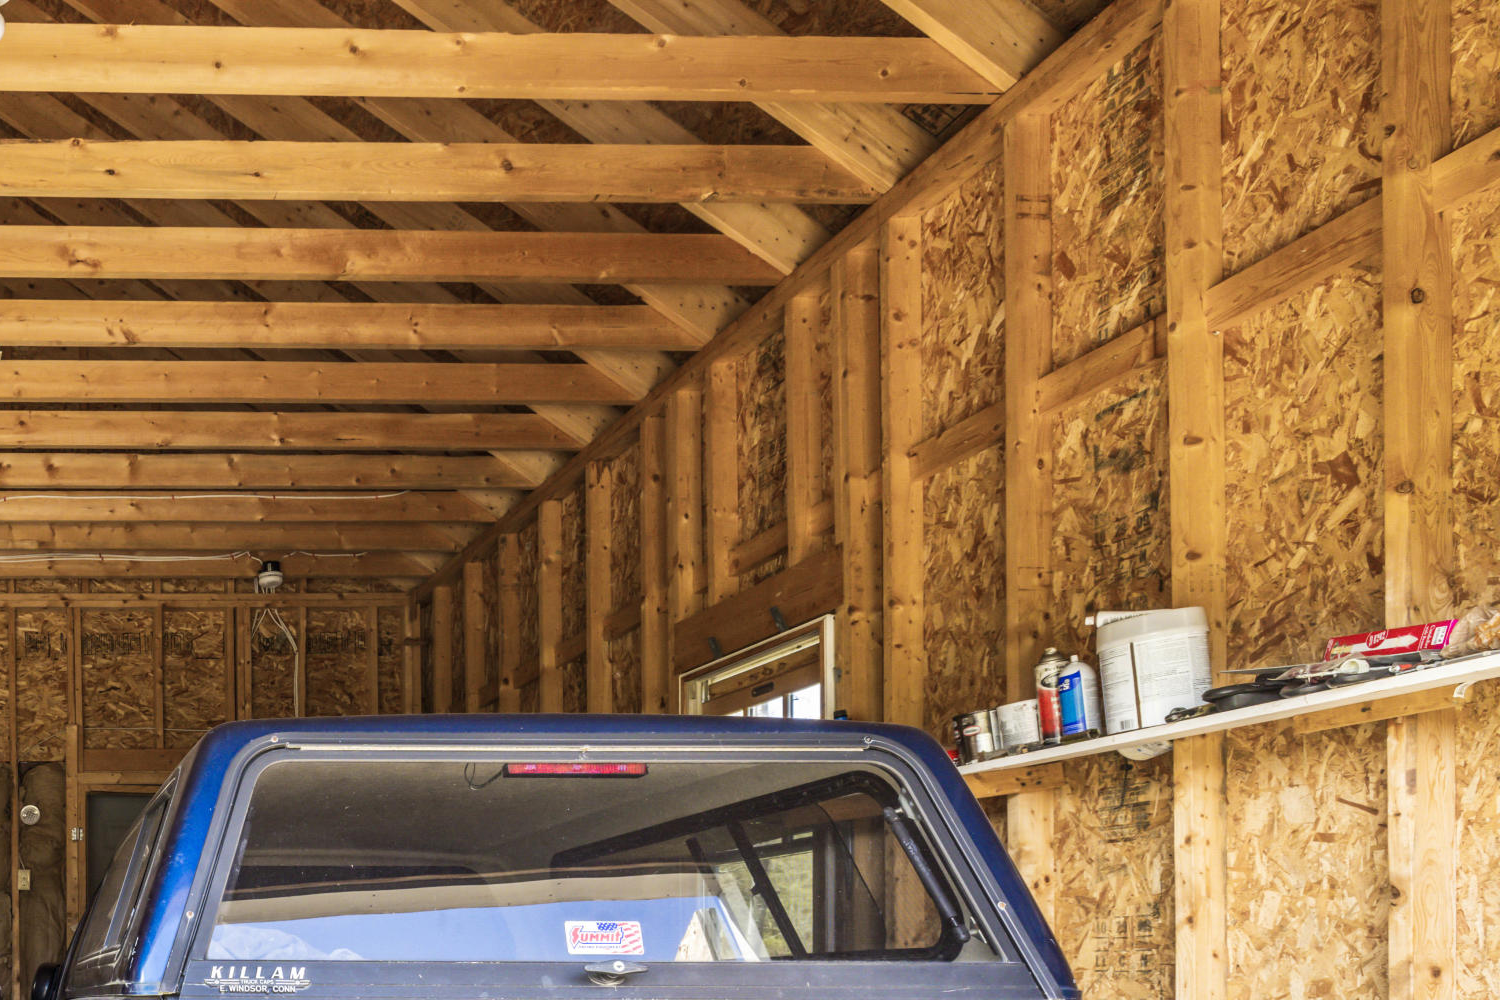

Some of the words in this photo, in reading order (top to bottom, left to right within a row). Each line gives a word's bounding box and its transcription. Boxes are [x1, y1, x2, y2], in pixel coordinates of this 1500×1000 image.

[210, 965, 306, 979] KILLAM
[219, 984, 228, 993] E.
[229, 985, 270, 994] WINDSOR,
